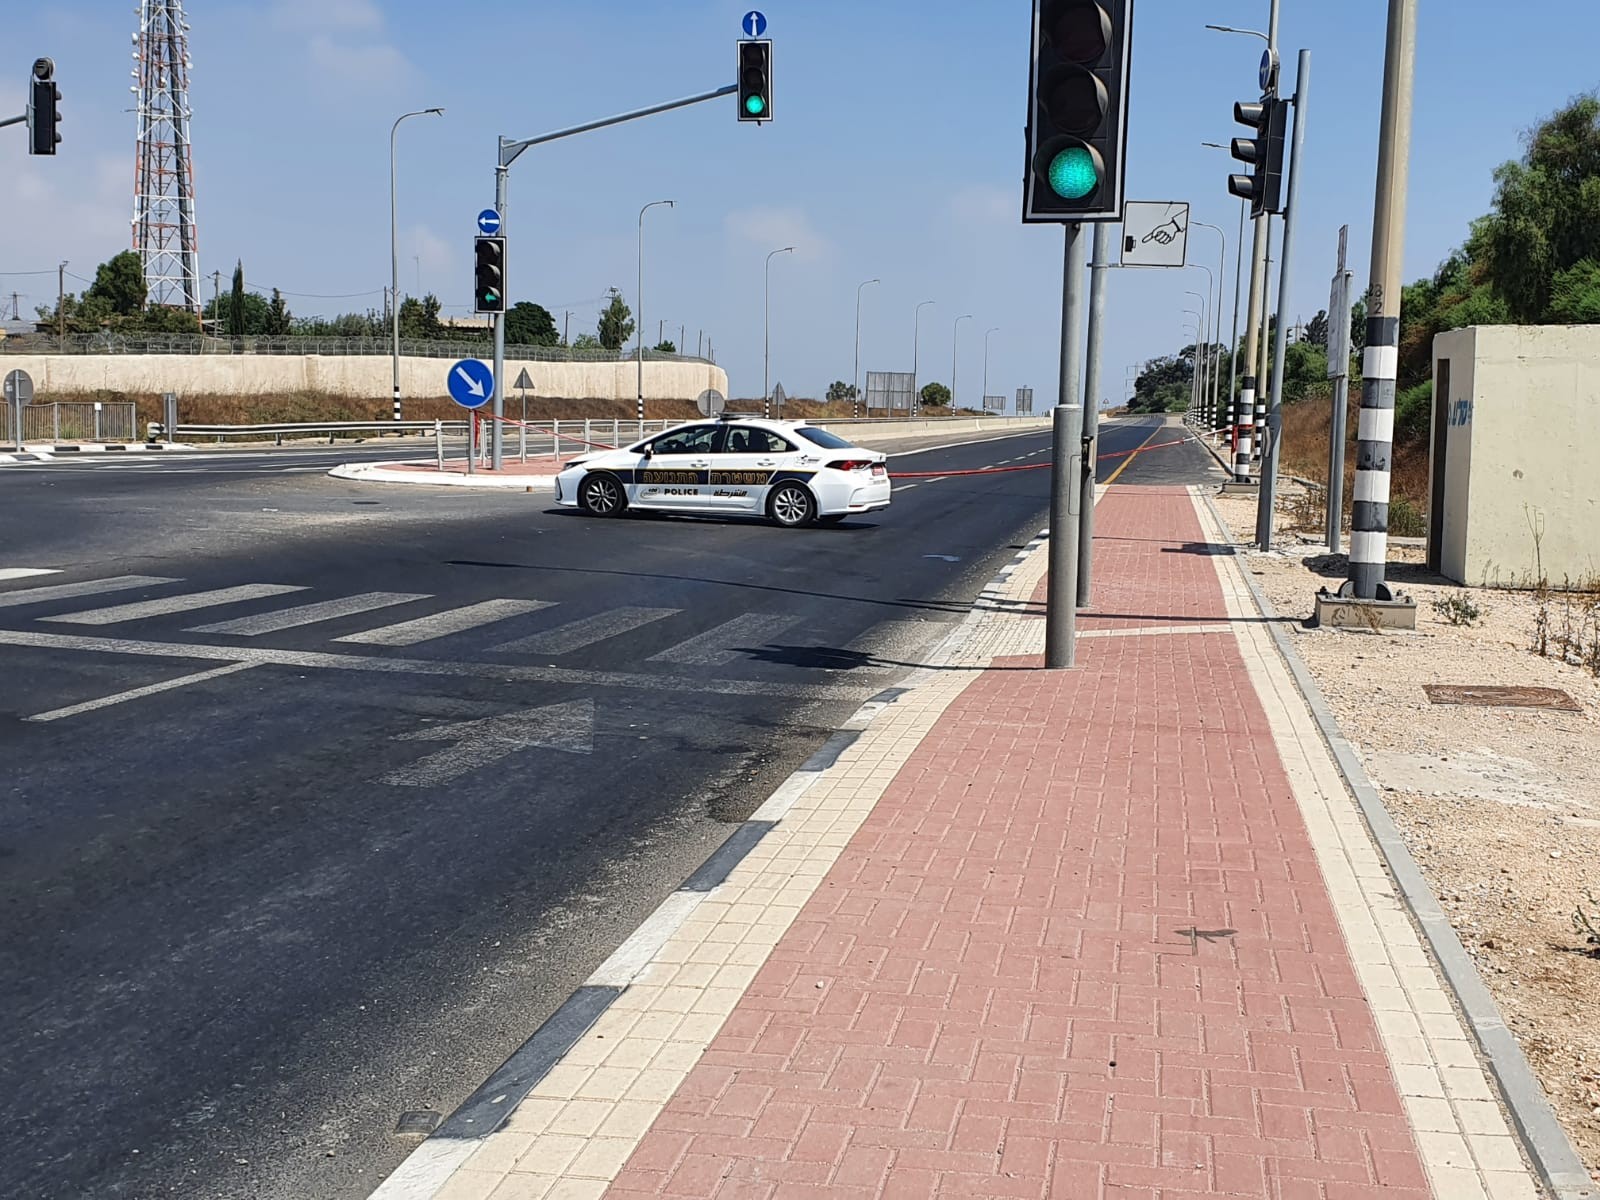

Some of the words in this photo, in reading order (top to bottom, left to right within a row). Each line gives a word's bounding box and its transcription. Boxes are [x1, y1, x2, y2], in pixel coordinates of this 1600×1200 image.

[1374, 302, 1383, 314] 2
[643, 472, 698, 484] התנועה
[711, 472, 768, 484] משטרת
[664, 488, 699, 496] POLICE
